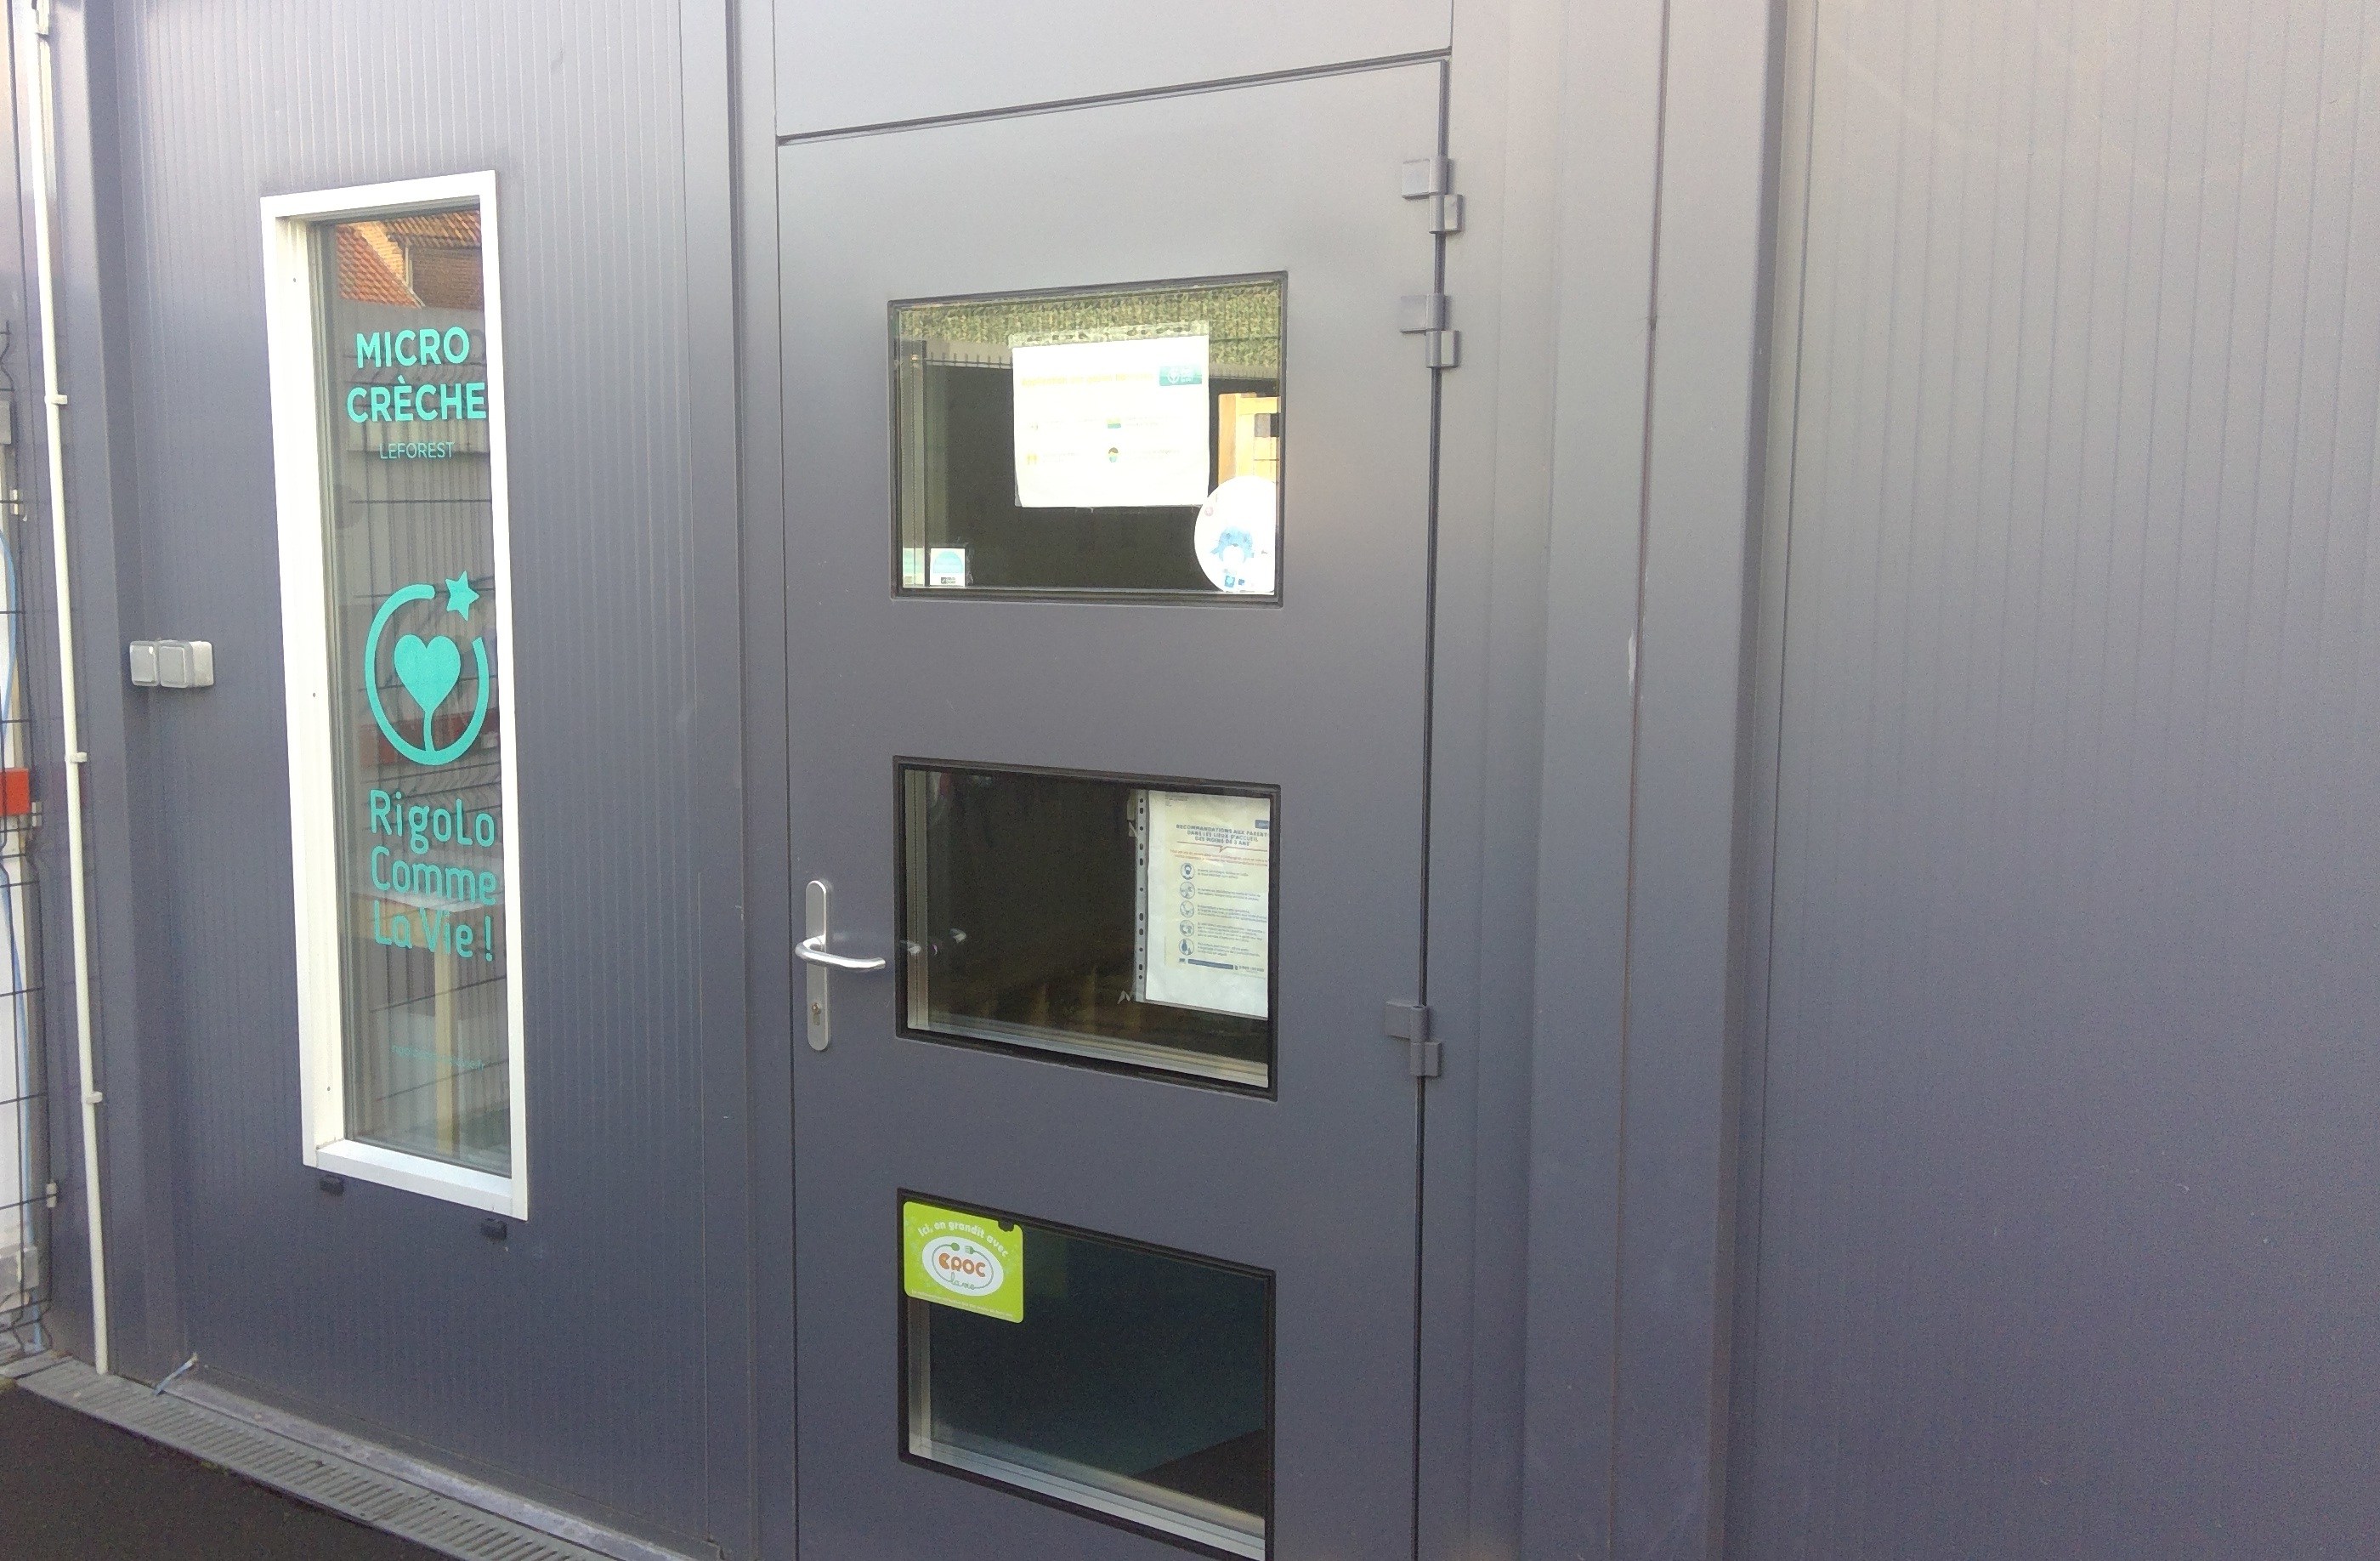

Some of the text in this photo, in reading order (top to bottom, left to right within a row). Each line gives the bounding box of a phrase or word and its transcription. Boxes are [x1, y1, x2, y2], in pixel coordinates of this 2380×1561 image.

[355, 326, 470, 369] MICRO
[346, 374, 487, 423] CRÈCHE
[378, 441, 456, 460] LEFOREST
[370, 845, 496, 905] Comme
[373, 899, 414, 950] La
[933, 1221, 947, 1230] on
[948, 1221, 985, 1239] grandit
[986, 1235, 1009, 1257] avec
[938, 1252, 986, 1278] CROC
